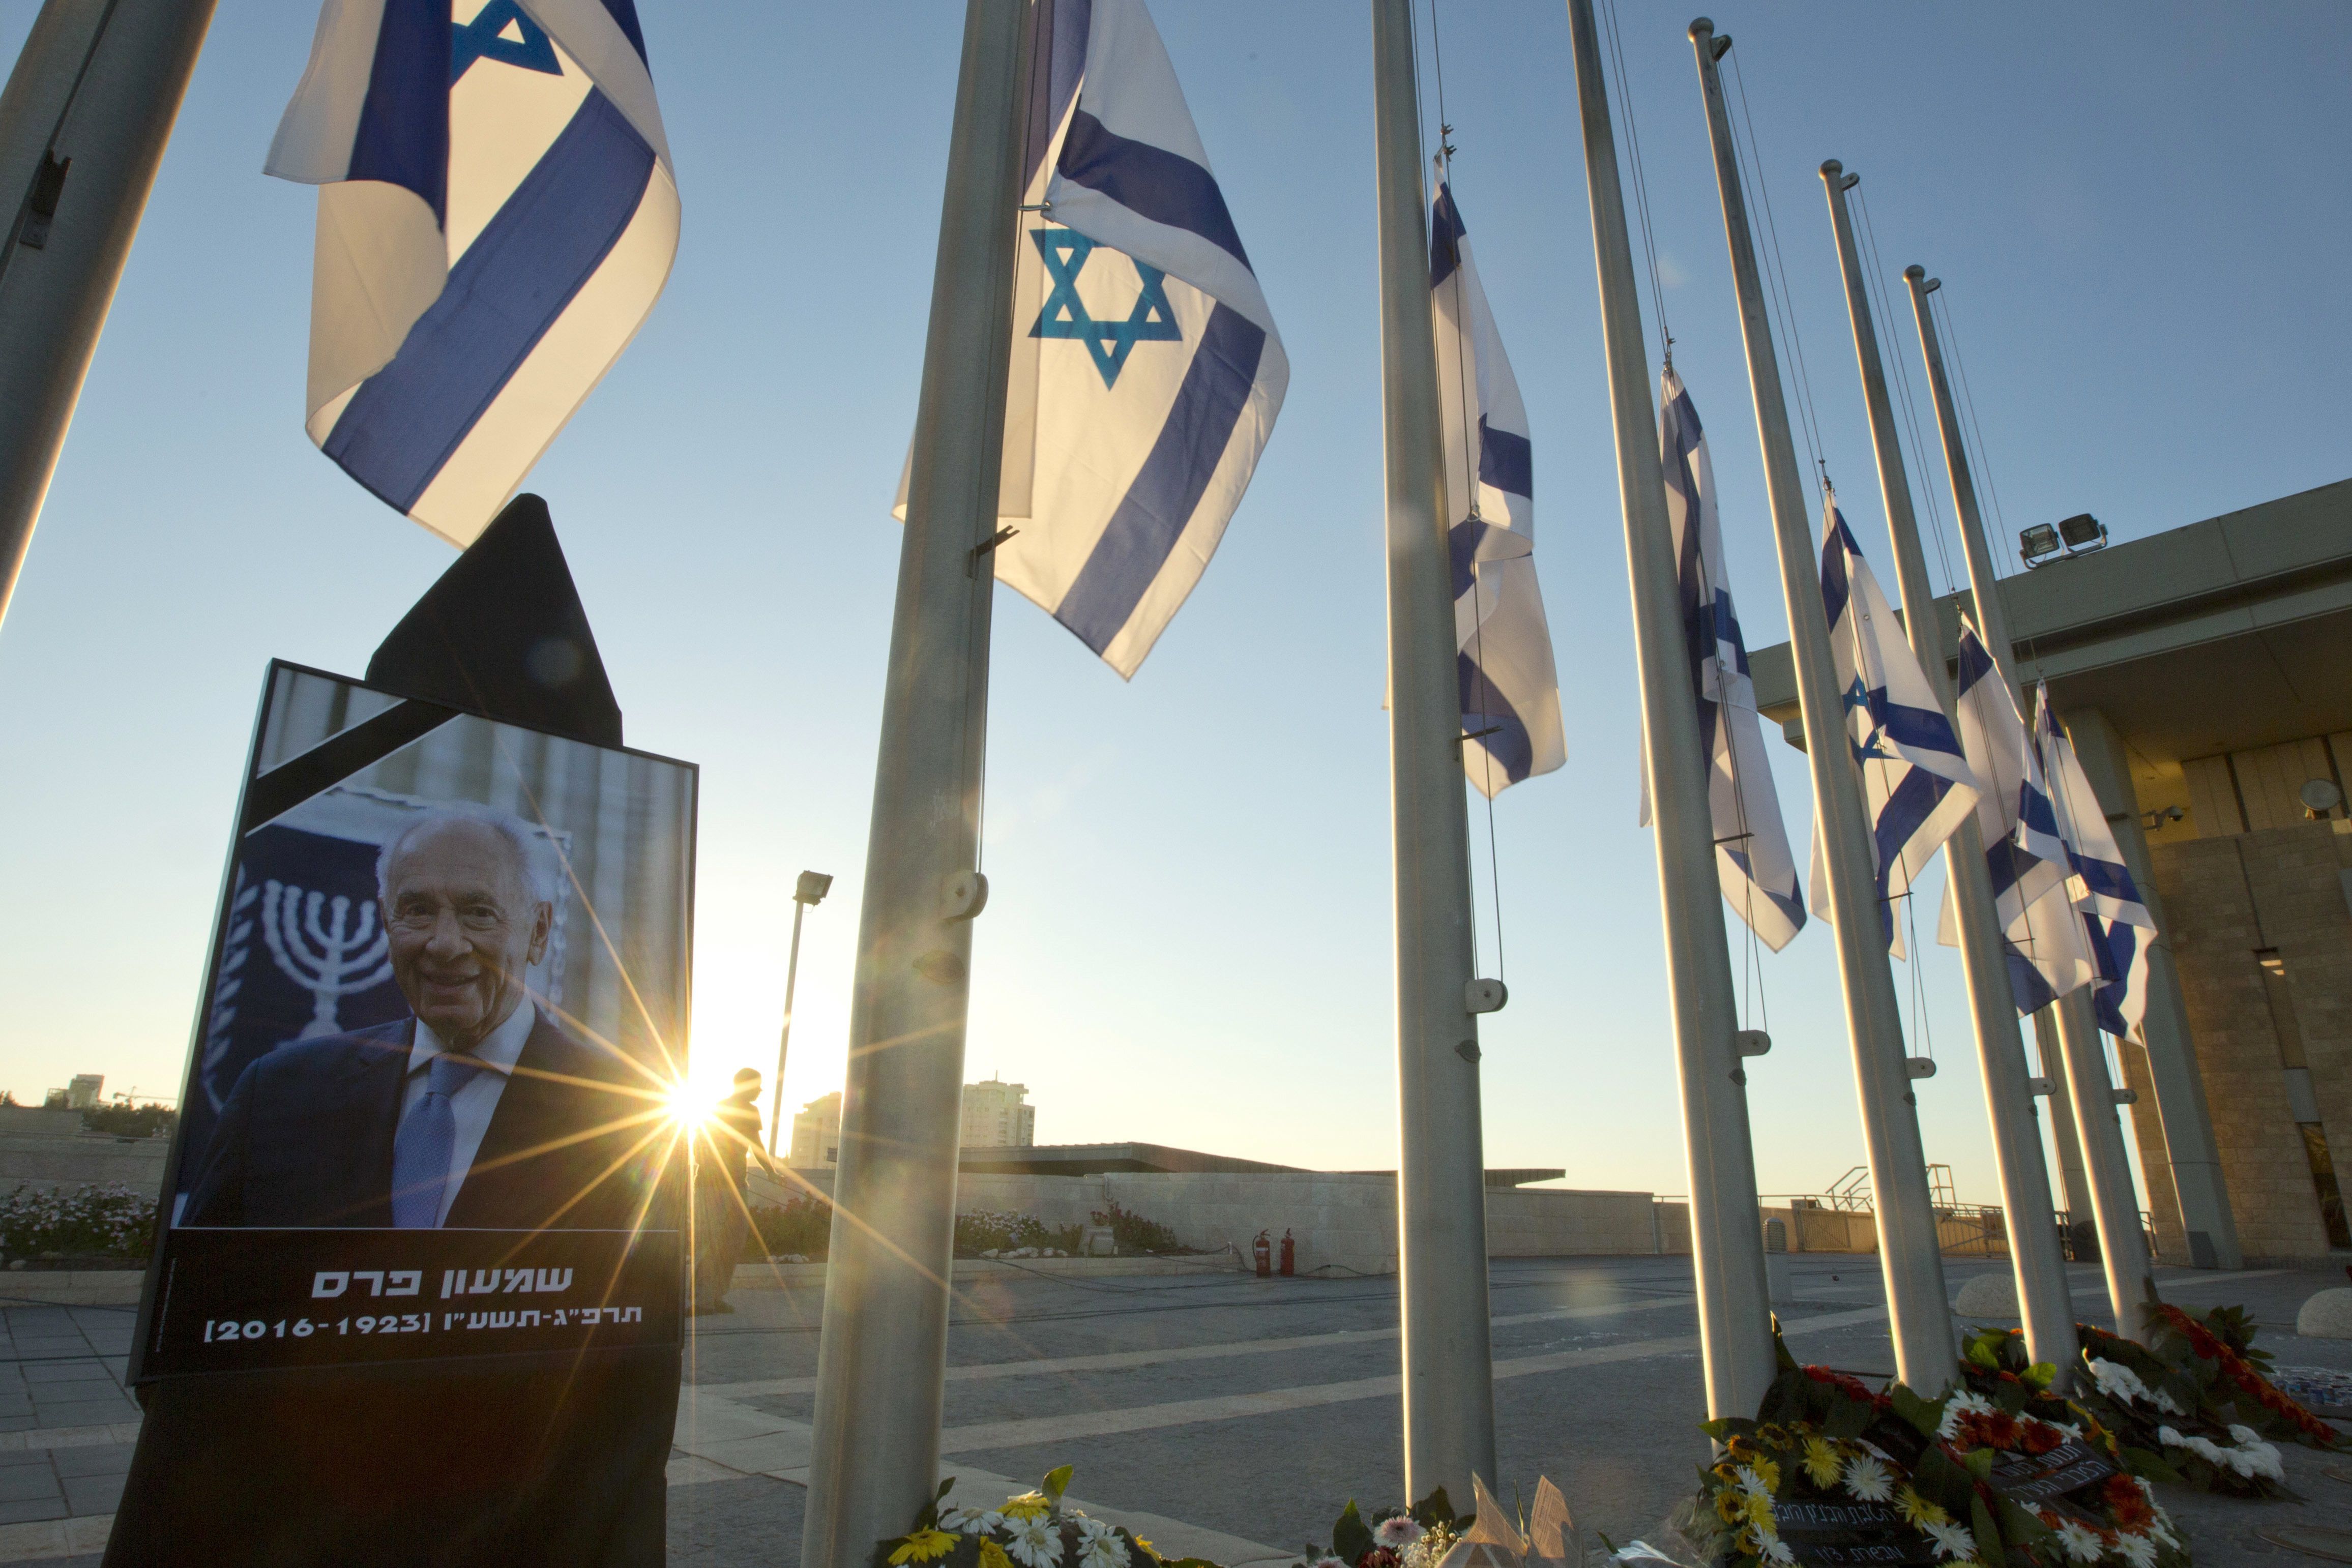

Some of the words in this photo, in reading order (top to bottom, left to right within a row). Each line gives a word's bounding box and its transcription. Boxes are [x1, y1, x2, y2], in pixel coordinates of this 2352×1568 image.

[311, 1270, 423, 1298] פרס
[440, 1267, 573, 1298] שמעון
[2035, 1444, 2083, 1468] תנועת
[1849, 1546, 1906, 1562] מבשרת
